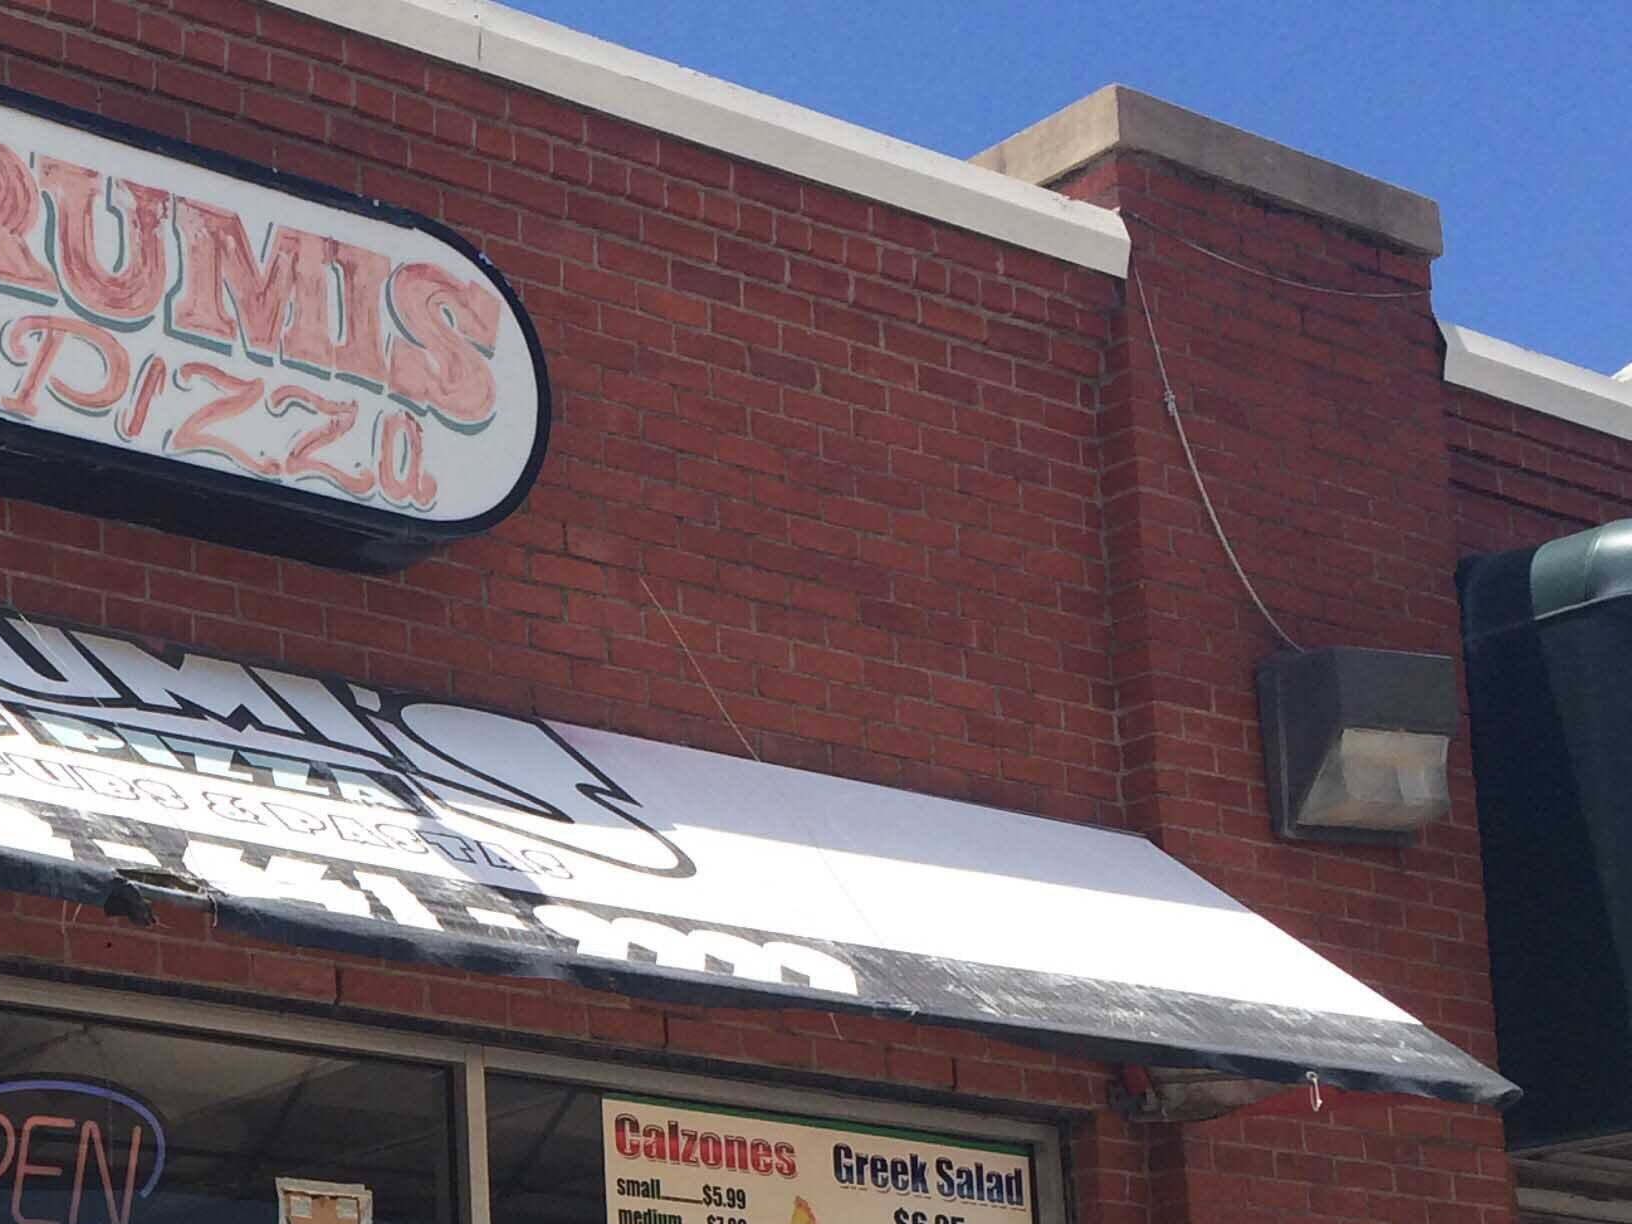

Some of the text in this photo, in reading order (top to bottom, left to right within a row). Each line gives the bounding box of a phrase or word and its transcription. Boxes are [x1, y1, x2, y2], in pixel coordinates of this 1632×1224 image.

[30, 709, 418, 812] PIZZA
[202, 791, 265, 825] &
[265, 801, 574, 880] PASTAS
[614, 1112, 798, 1179] Calzones
[833, 1143, 1026, 1208] Greek Salad
